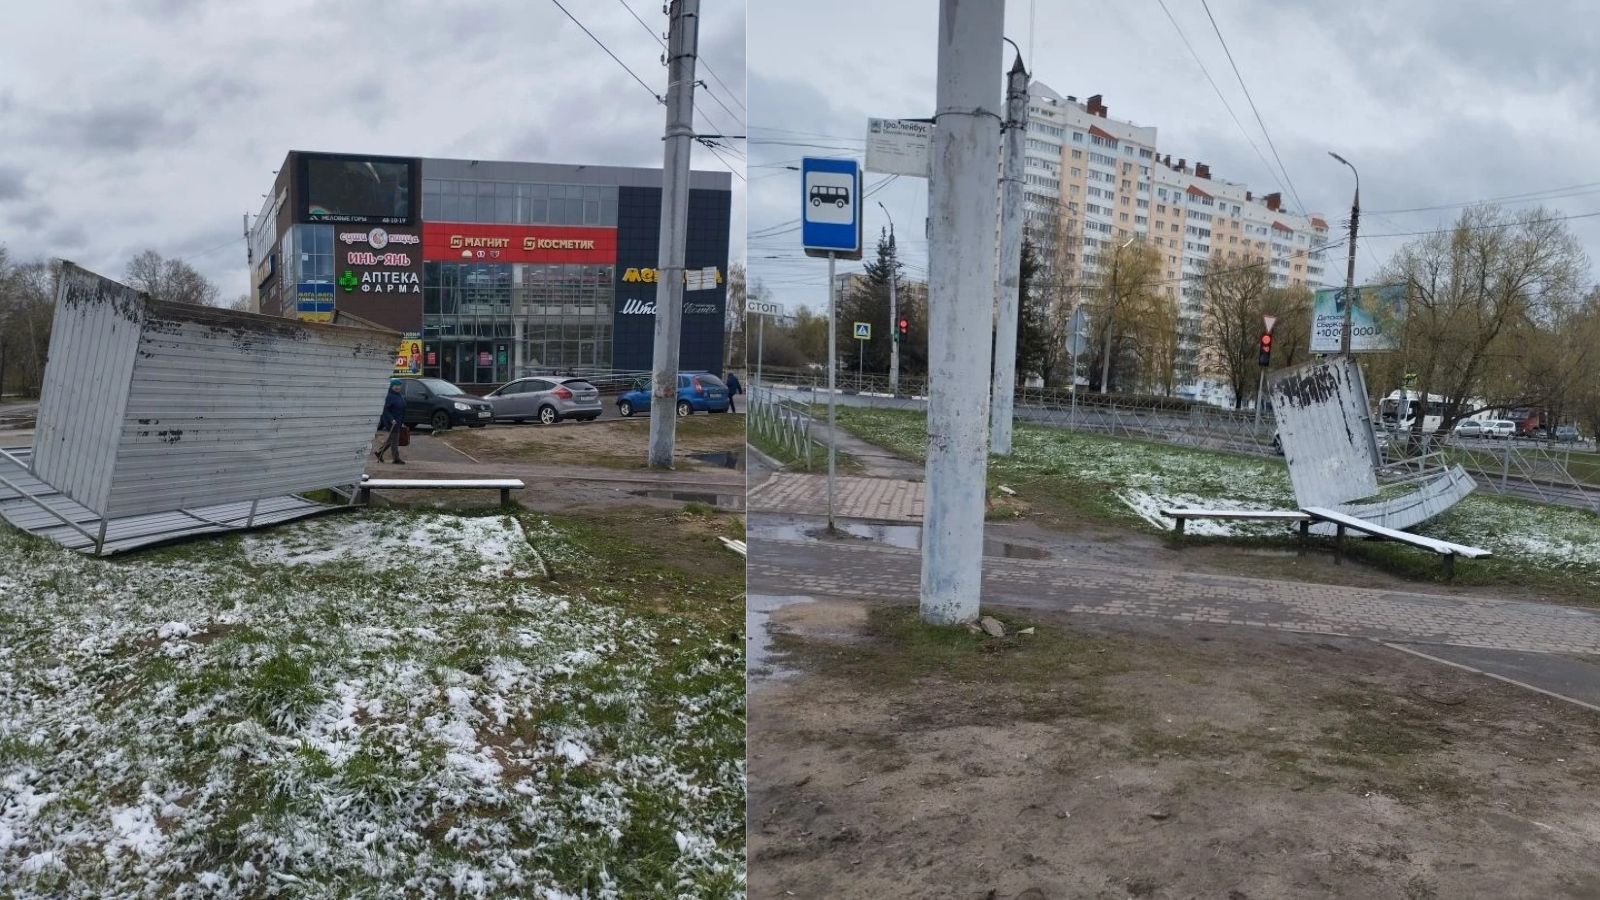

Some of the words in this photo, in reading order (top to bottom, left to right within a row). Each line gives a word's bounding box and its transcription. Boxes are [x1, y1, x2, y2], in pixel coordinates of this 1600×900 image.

[882, 120, 926, 133] Тролейбус
[464, 237, 510, 248] МАГНИТ
[537, 238, 595, 249] КОСМЕТИК
[347, 252, 411, 266] ИНЬ-ЯНЬ
[361, 271, 420, 284] АПТЕКА
[361, 284, 420, 293] ФАРМА
[748, 301, 777, 313] СТОП
